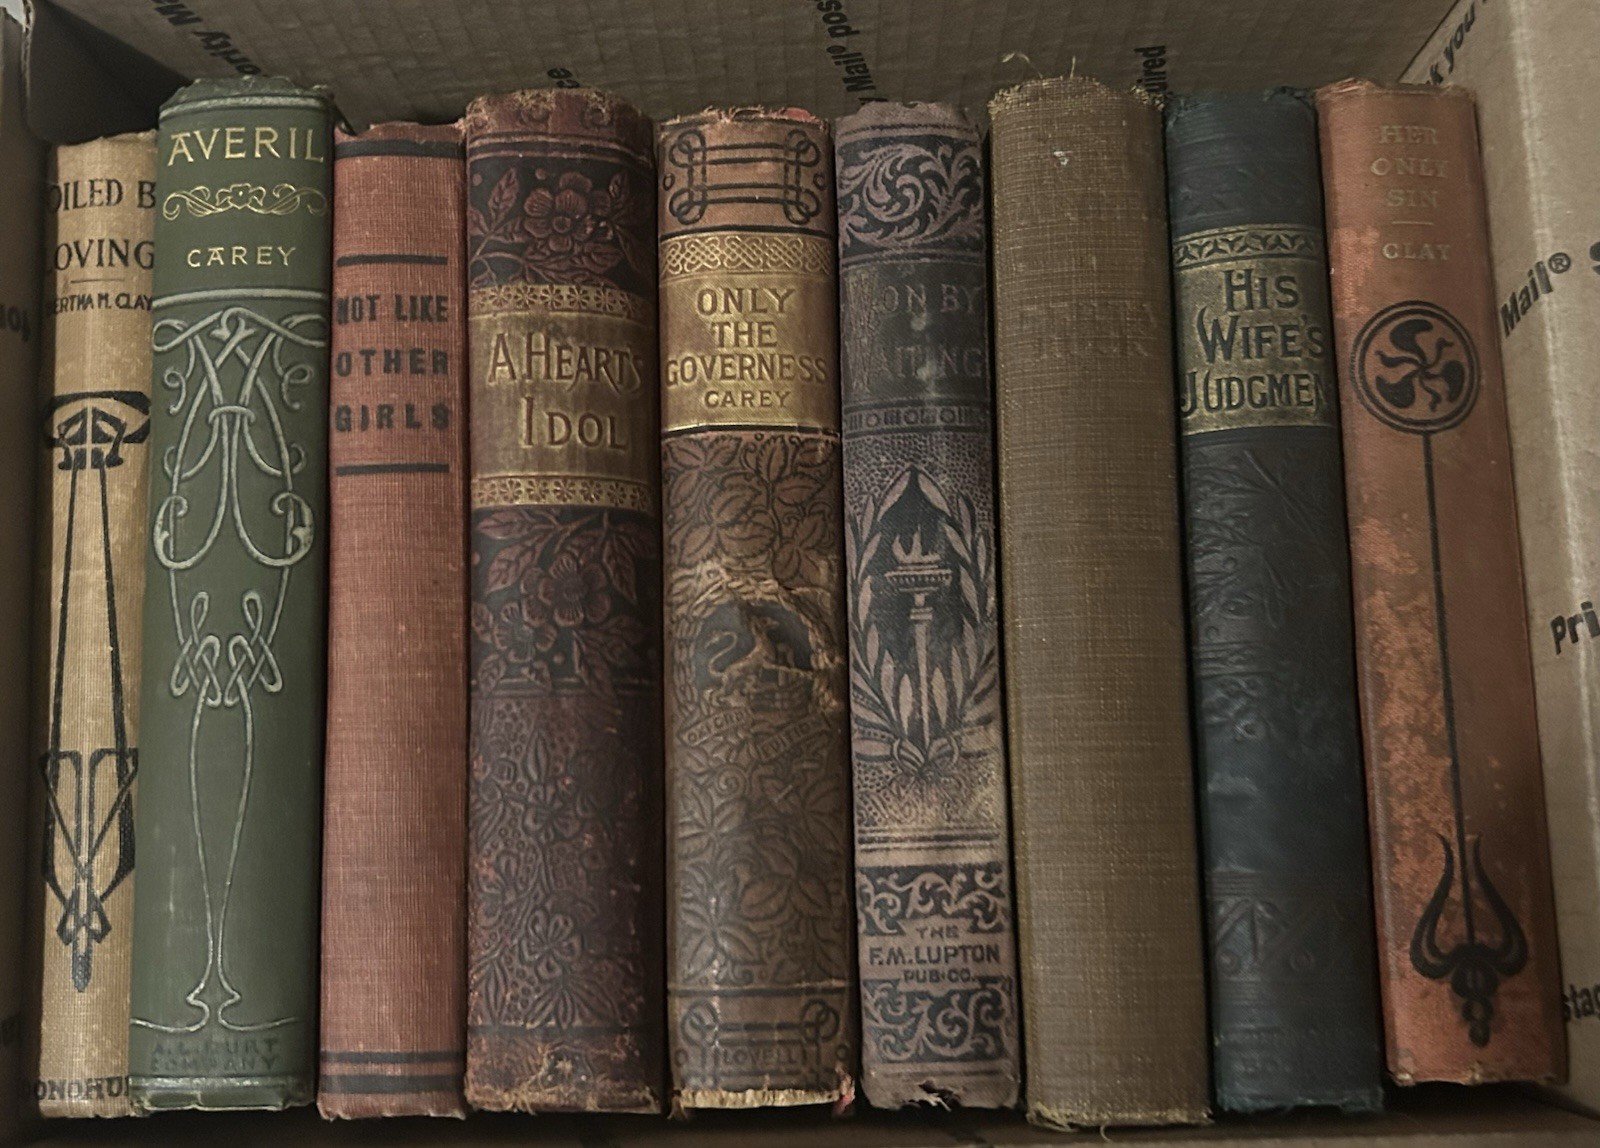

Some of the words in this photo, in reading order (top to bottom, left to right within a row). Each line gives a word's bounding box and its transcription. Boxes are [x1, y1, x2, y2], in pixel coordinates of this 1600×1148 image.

[167, 127, 324, 167] AVERIL
[1379, 125, 1440, 145] HER
[1370, 157, 1450, 178] ONLY
[1387, 189, 1439, 208] SIN
[45, 238, 155, 274] OVING
[186, 245, 296, 268] CAREY
[1382, 243, 1451, 261] CLAY
[45, 293, 95, 317] ERTHA
[115, 292, 153, 311] CLAY
[697, 287, 795, 316] ONLY
[870, 283, 927, 314] ON
[940, 283, 983, 315] BY
[1223, 269, 1299, 312] HIS
[337, 294, 380, 324] NOT
[395, 294, 448, 322] LIKE
[711, 321, 778, 348] THE
[1197, 307, 1326, 364] WIFE'S
[335, 348, 448, 377] OTHER
[487, 333, 517, 383] A
[665, 354, 828, 389] GOVERNESS
[704, 390, 791, 409] CAREY
[335, 403, 449, 431] GIRLS
[523, 395, 627, 451] IDOL
[915, 925, 959, 939] THE
[33, 1076, 128, 1101] ONOHU
